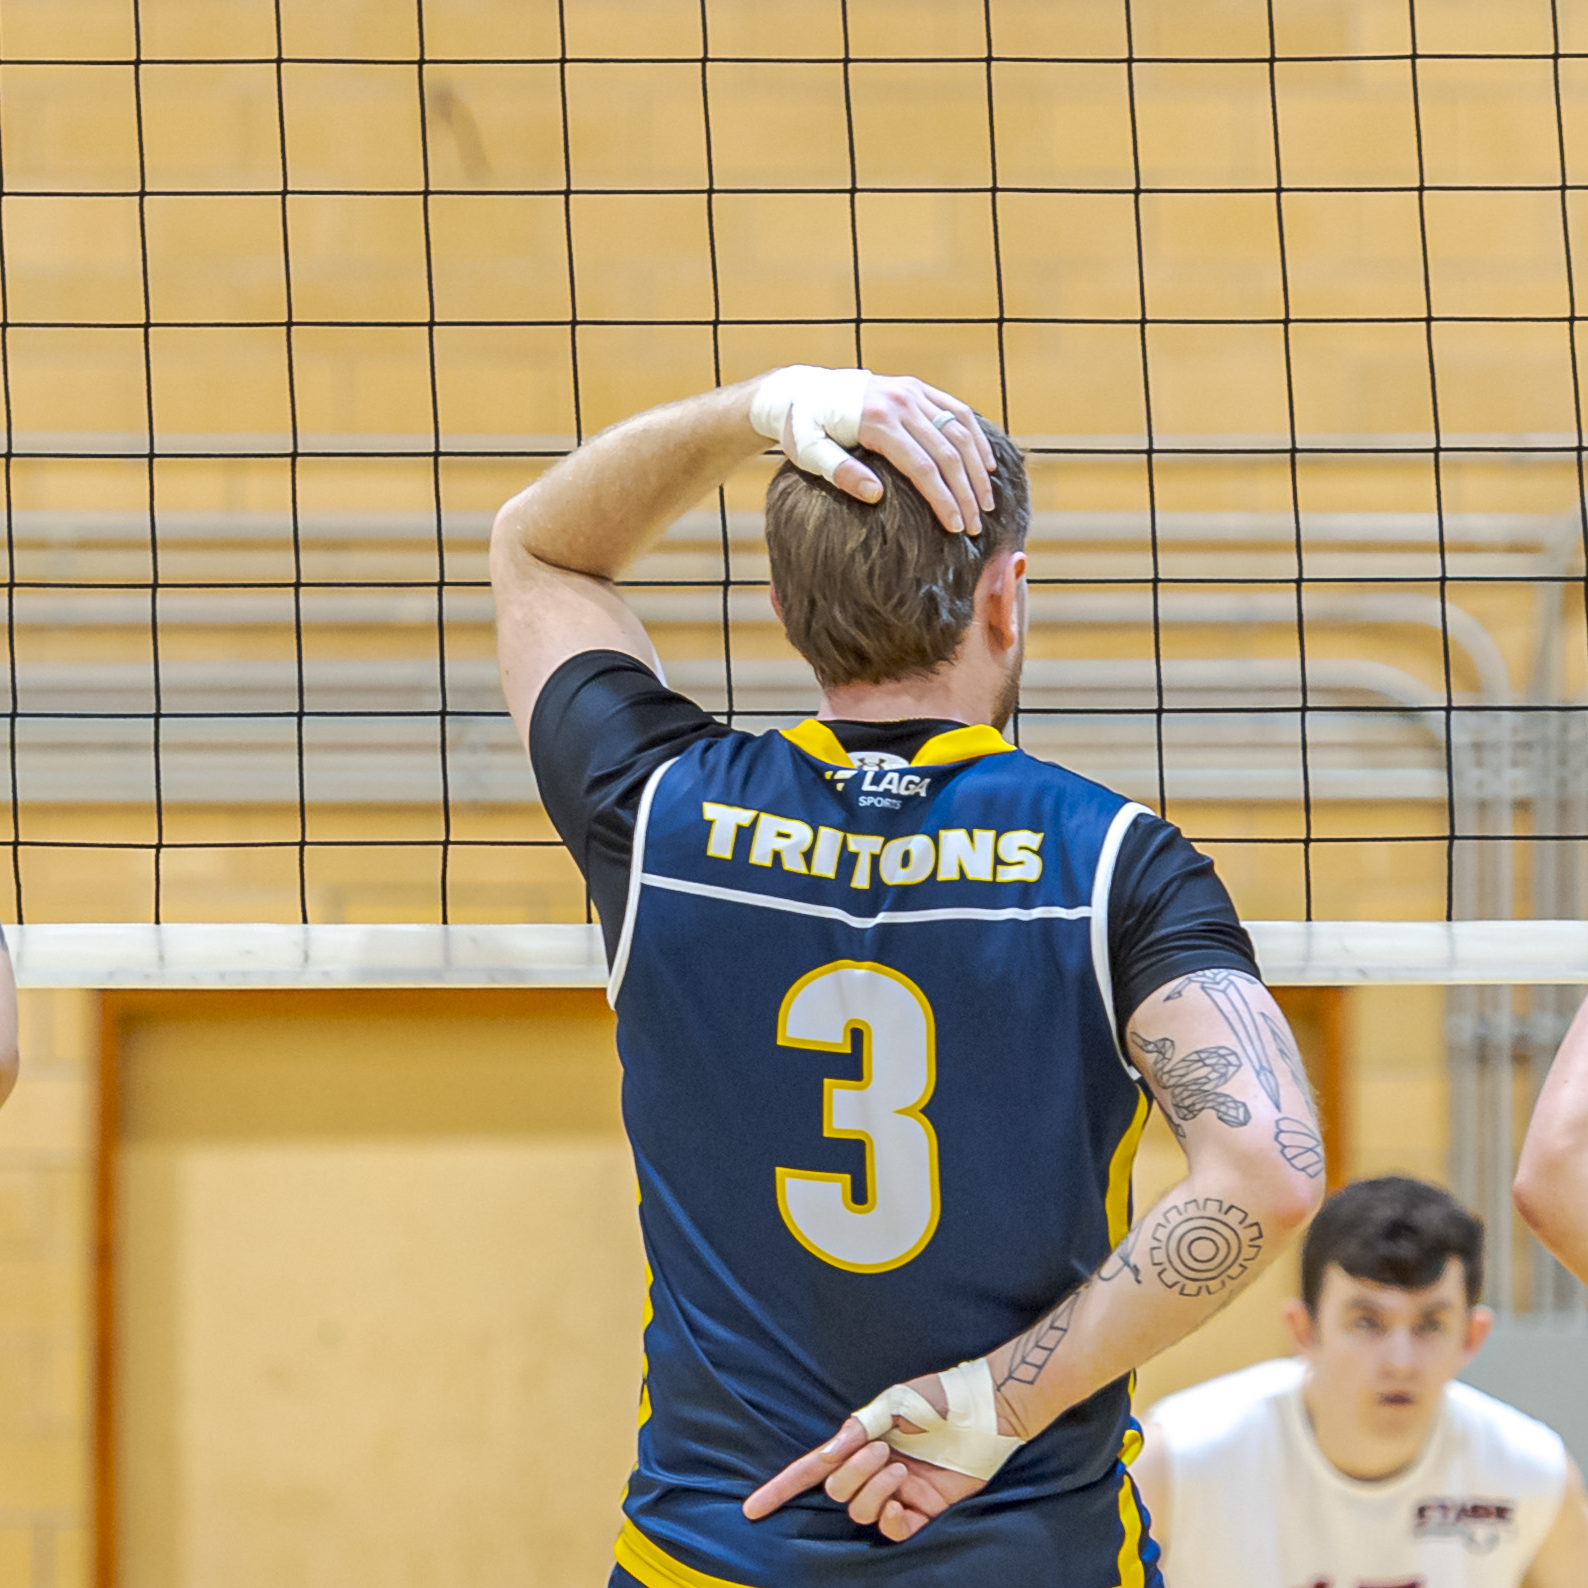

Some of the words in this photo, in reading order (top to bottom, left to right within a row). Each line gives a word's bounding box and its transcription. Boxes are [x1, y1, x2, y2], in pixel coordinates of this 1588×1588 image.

[861, 771, 931, 797] LAGA
[702, 801, 1045, 890] TRITONS
[775, 959, 942, 1274] 3
